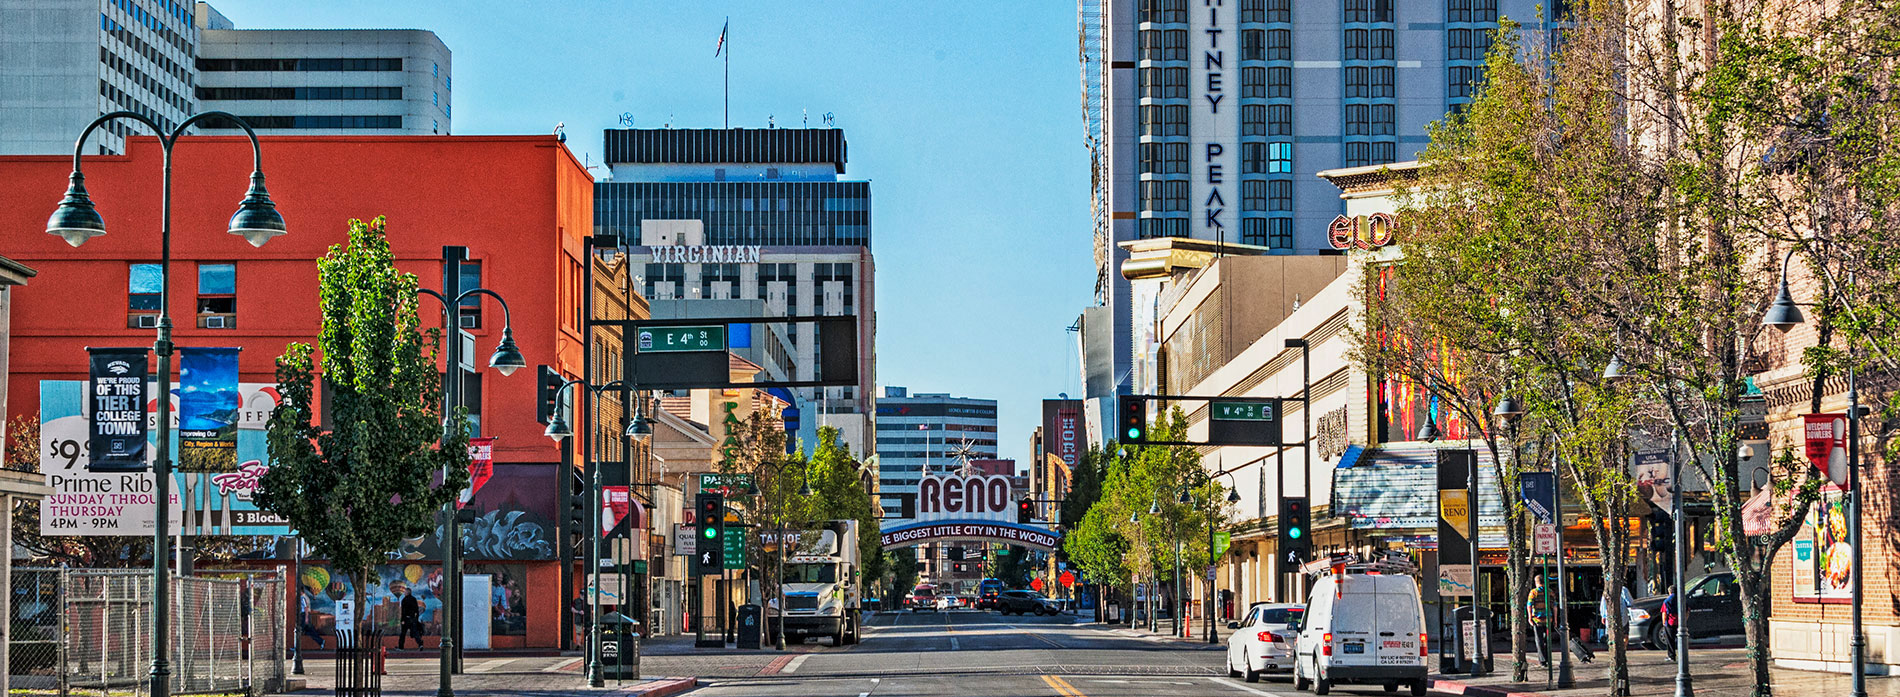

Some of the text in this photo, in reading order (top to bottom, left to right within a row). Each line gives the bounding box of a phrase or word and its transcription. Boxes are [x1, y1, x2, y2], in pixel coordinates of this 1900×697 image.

[1206, 0, 1224, 228] ITNEY PEAK
[650, 245, 761, 263] VIRGINIAN
[667, 331, 707, 345] E 4th St
[699, 339, 708, 347] 00
[96, 384, 140, 396] OF THIS
[96, 396, 140, 411] TIER 1
[96, 411, 141, 421] COLLEGE
[1223, 406, 1230, 415] W
[96, 421, 140, 435] TOWN.
[1806, 422, 1832, 430] WELCOME
[1807, 431, 1832, 439] BOWLERS
[51, 473, 153, 493] Prime Rib
[50, 494, 178, 505] SUNDAY THROUH
[921, 477, 1008, 513] RENO
[50, 506, 124, 517] THURSDAY
[1443, 508, 1466, 516] RENO
[237, 513, 244, 523] 3
[50, 519, 78, 529] 4PM
[91, 519, 119, 529] 9PM
[881, 525, 1056, 547] HE BIGGEST LITTLE CITY IN THE WORLD
